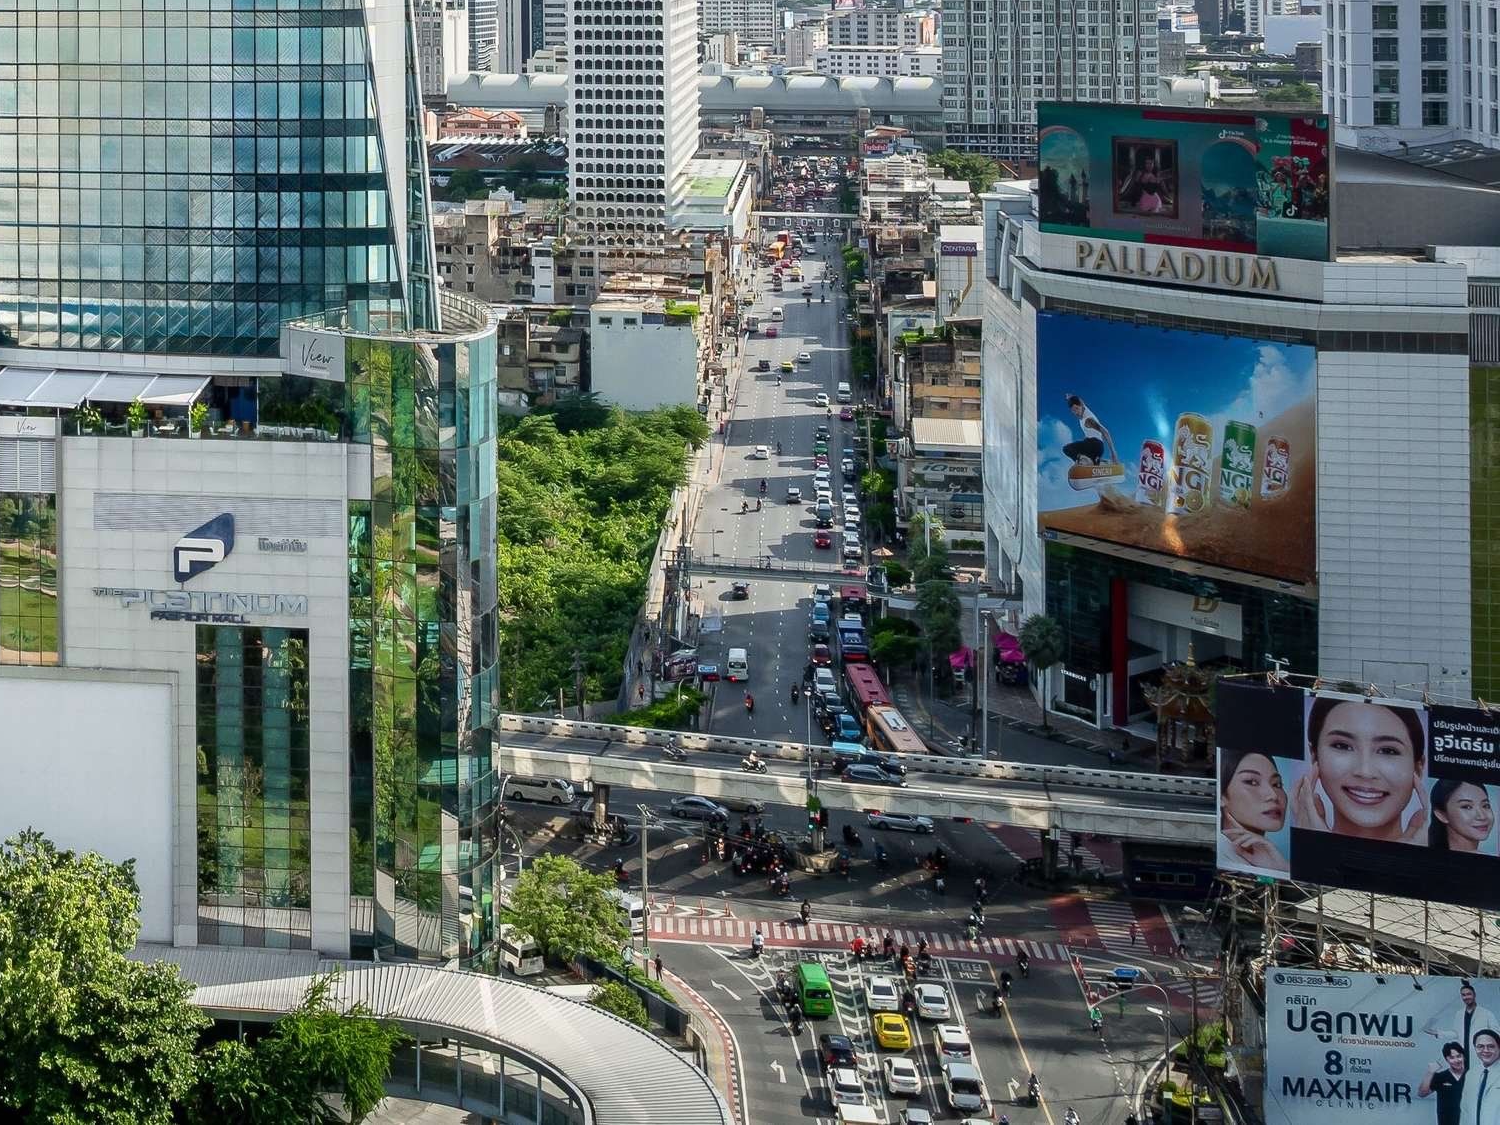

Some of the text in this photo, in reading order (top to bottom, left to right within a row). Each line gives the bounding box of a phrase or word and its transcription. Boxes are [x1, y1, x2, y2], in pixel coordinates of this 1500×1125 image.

[1075, 241, 1279, 291] PALLADIUM
[302, 338, 335, 366] View
[119, 589, 308, 615] PLATINUM
[1285, 994, 1317, 1006] คลินิก
[1286, 1006, 1413, 1043] ปลูกผม
[1324, 1050, 1343, 1075] 8
[1349, 1057, 1372, 1066] สาขา
[1282, 1076, 1412, 1104] MAXHAIR
[1316, 1099, 1375, 1110] CLINIC
